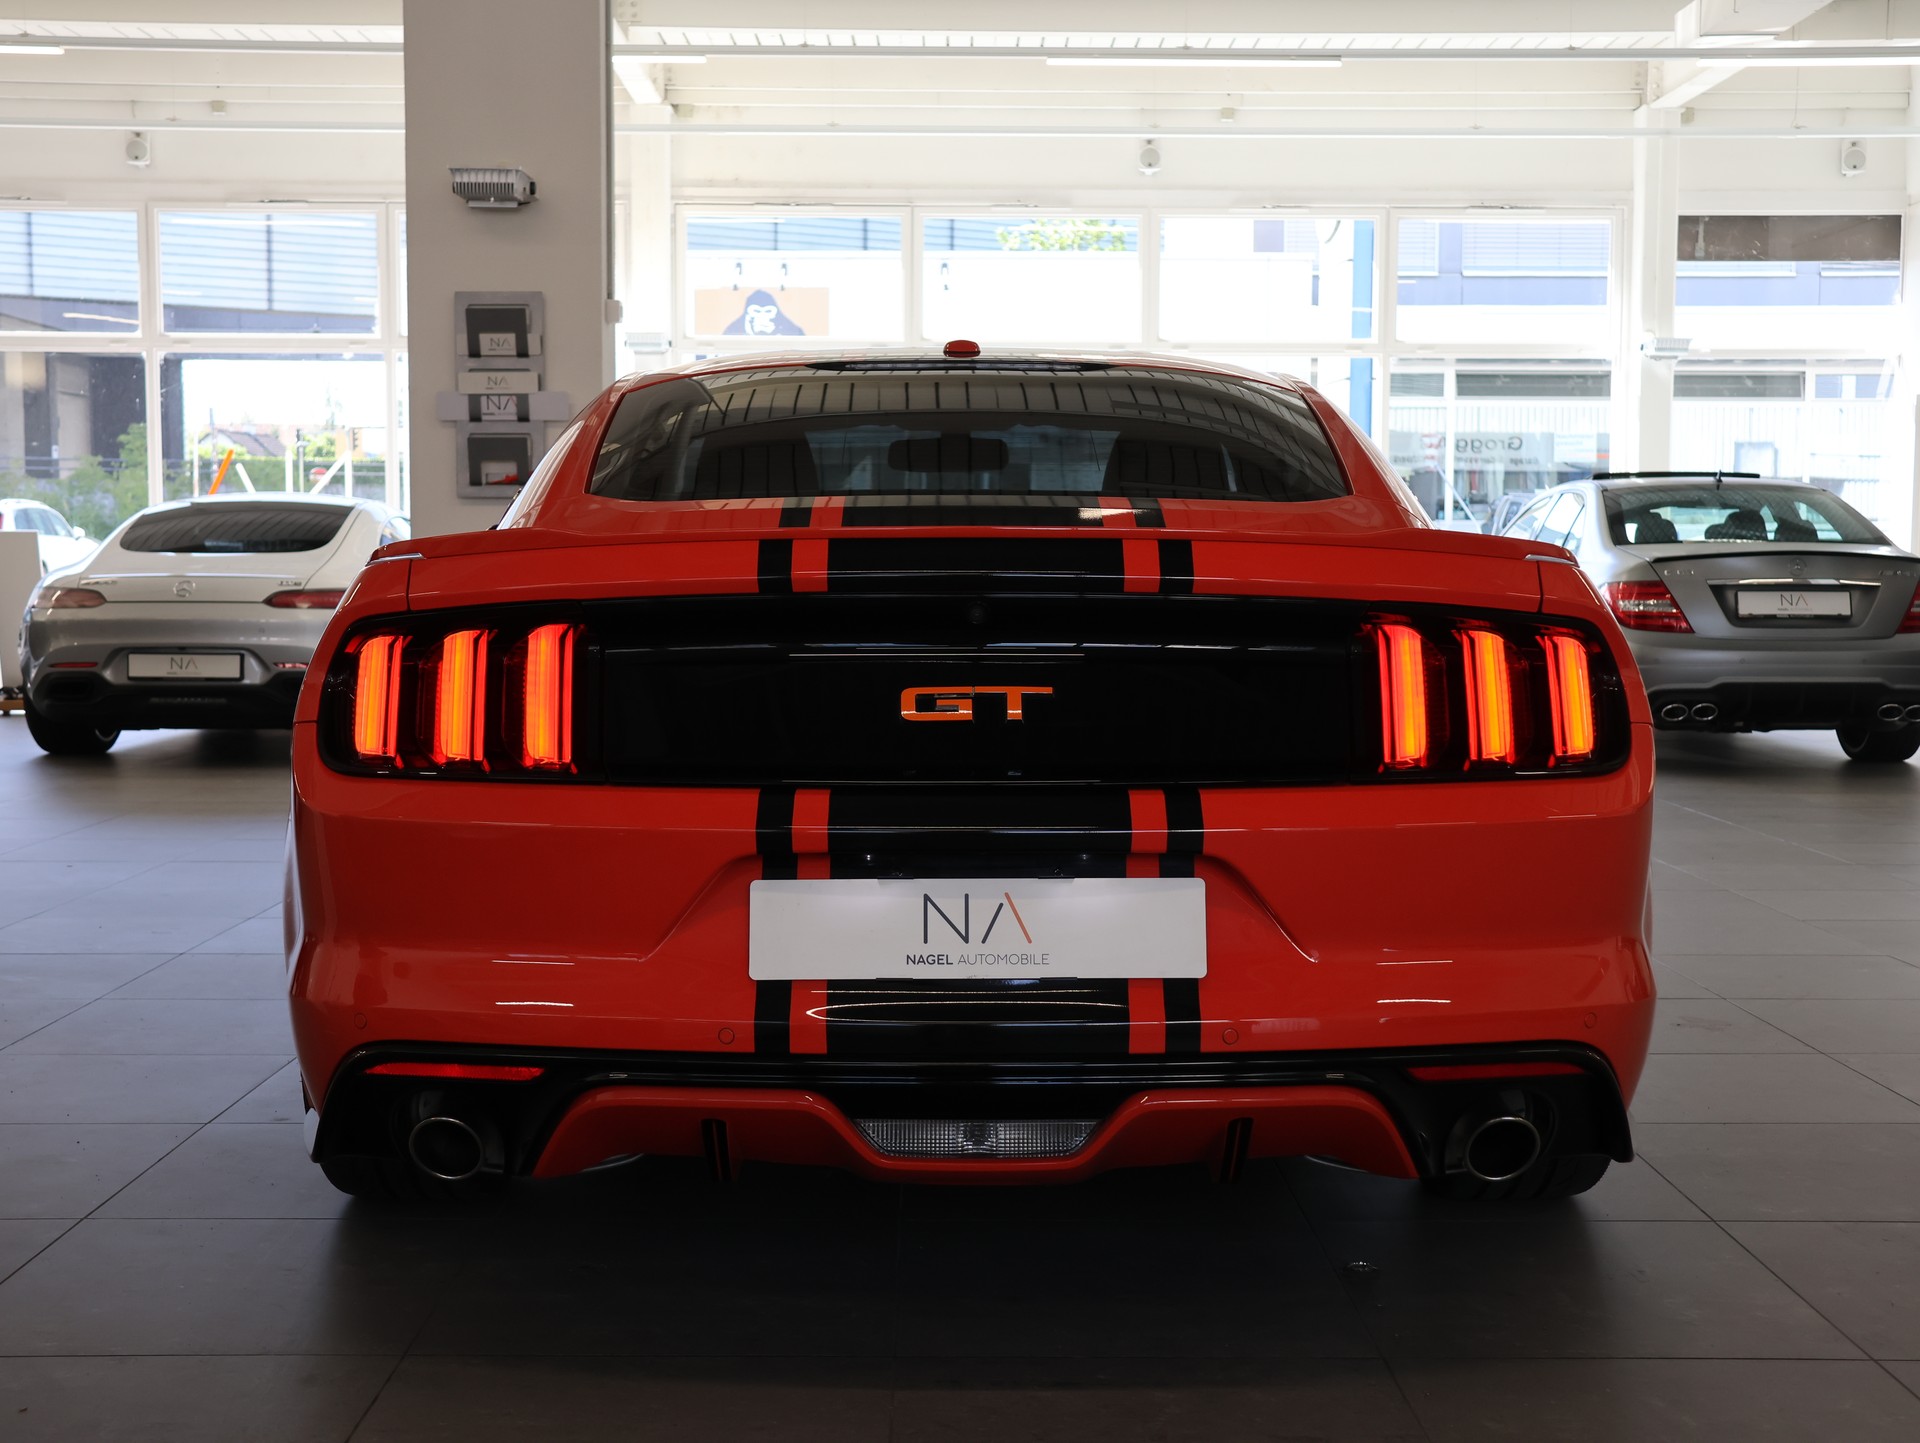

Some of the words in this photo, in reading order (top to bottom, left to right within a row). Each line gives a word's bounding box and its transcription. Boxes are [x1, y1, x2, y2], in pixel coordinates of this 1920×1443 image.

[1780, 593, 1808, 606] NA
[170, 656, 198, 670] NA
[901, 686, 1053, 721] GT
[923, 892, 1032, 944] NA
[906, 953, 953, 965] NAGEL
[957, 953, 1050, 965] AUTOMOBILE
